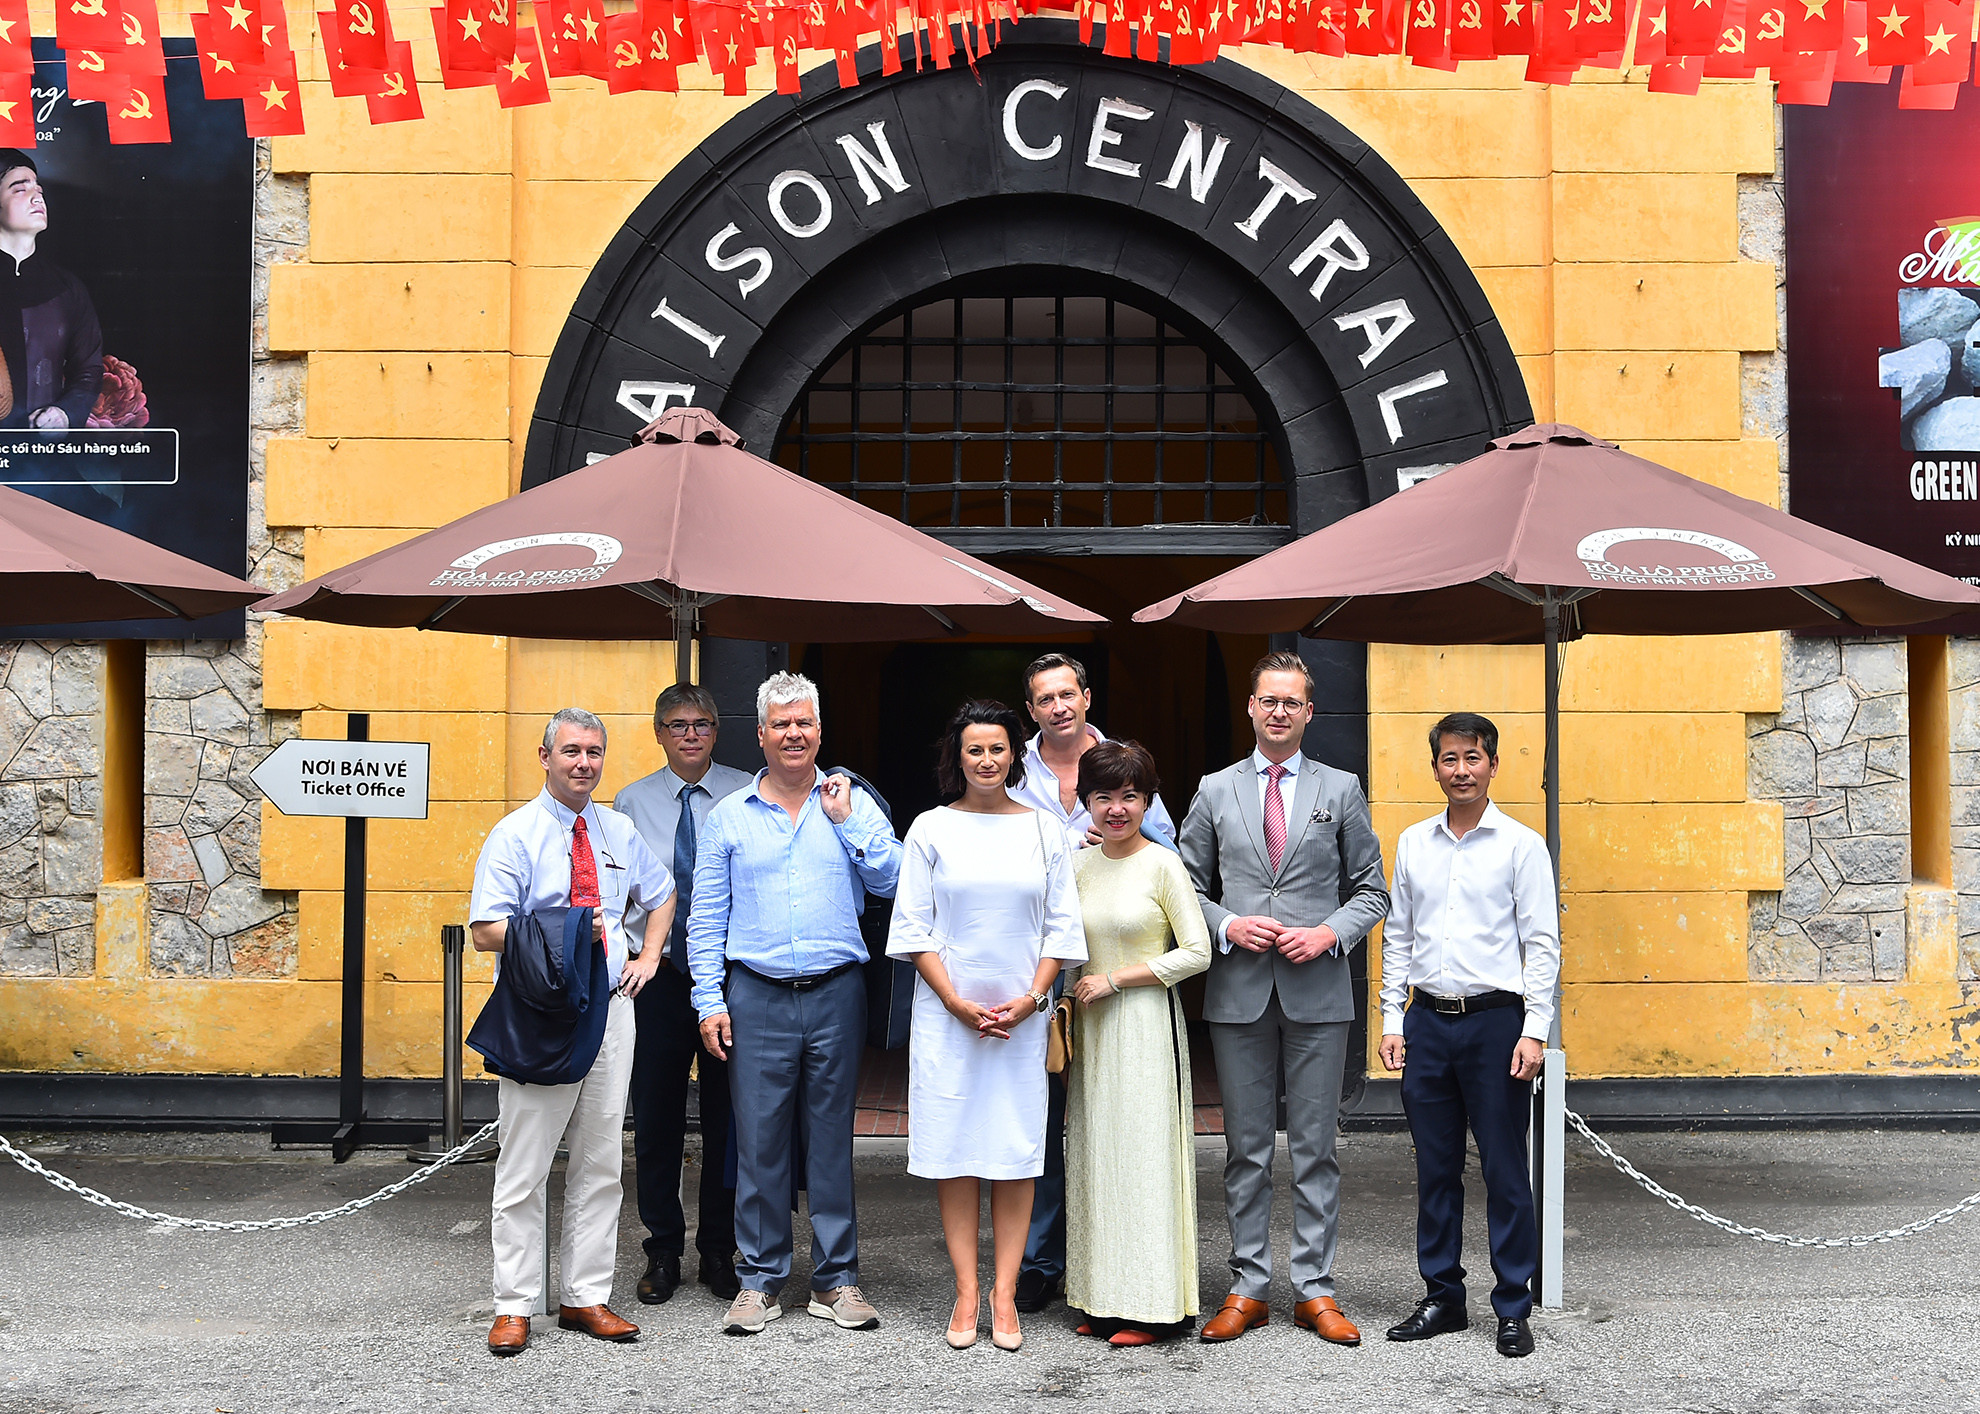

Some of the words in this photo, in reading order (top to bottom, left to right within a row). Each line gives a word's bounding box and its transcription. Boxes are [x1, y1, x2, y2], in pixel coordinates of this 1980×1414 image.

[35, 127, 61, 141] oa”
[586, 120, 912, 466] AISON
[11, 442, 30, 454] tối
[31, 442, 56, 454] thứ
[57, 442, 81, 454] Sáu
[84, 442, 118, 456] hàng
[1909, 460, 1978, 501] GREEN
[526, 563, 615, 581] PRISON
[1590, 573, 1608, 582] DI
[1676, 561, 1773, 577] PRISON
[301, 759, 335, 776] NƠI
[340, 759, 379, 777] BÁN
[384, 760, 407, 778] VÉ
[301, 780, 352, 796] Ticket
[356, 782, 406, 797] Office
